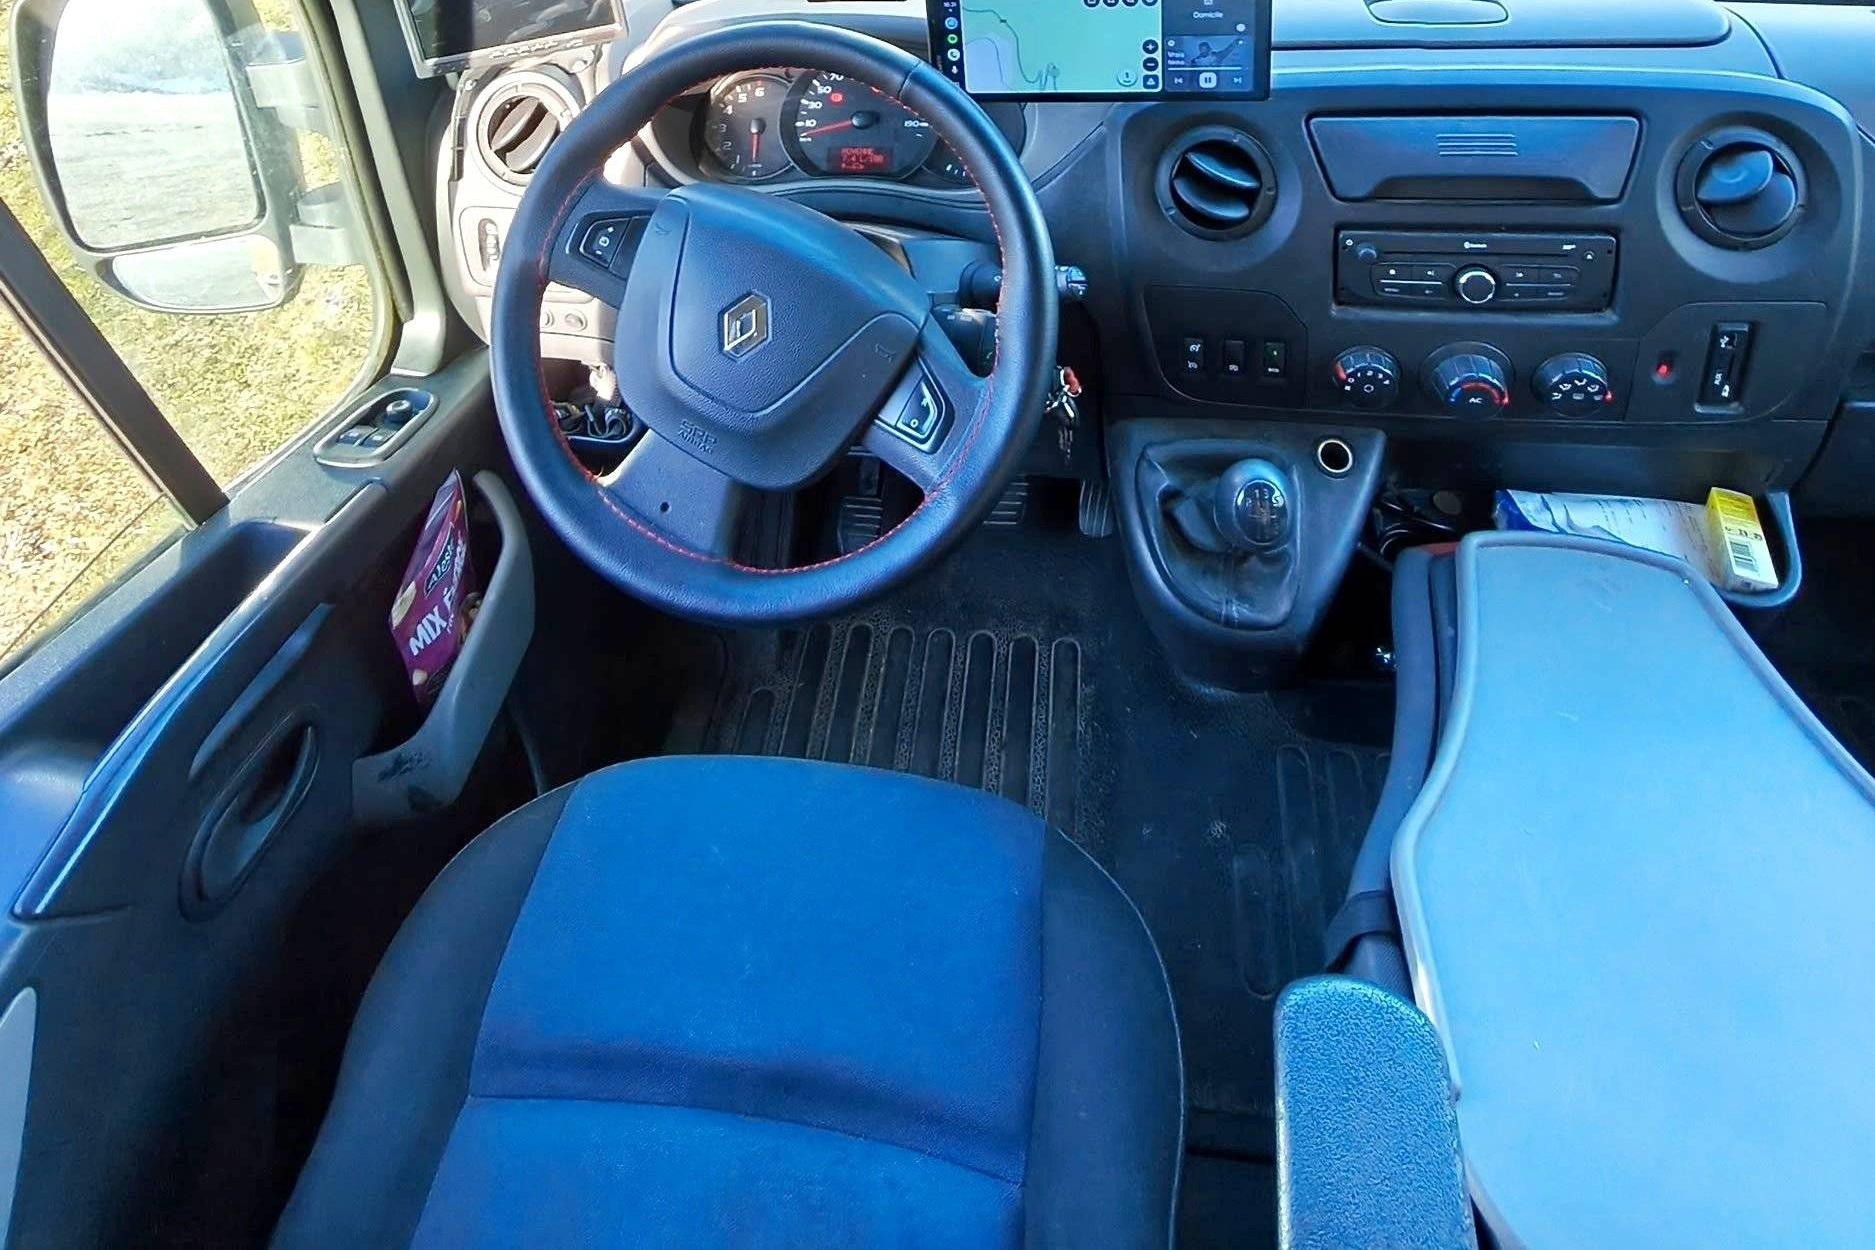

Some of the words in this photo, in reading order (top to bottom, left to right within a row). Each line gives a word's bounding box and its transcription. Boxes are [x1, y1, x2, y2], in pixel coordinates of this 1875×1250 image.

[755, 87, 765, 97] 6
[817, 85, 832, 94] 50
[738, 93, 747, 103] 5
[723, 104, 733, 115] 4
[807, 101, 823, 110] 30
[720, 123, 728, 133] 3
[805, 118, 817, 128] 10
[723, 141, 732, 151] 2
[408, 605, 447, 656] MIX
